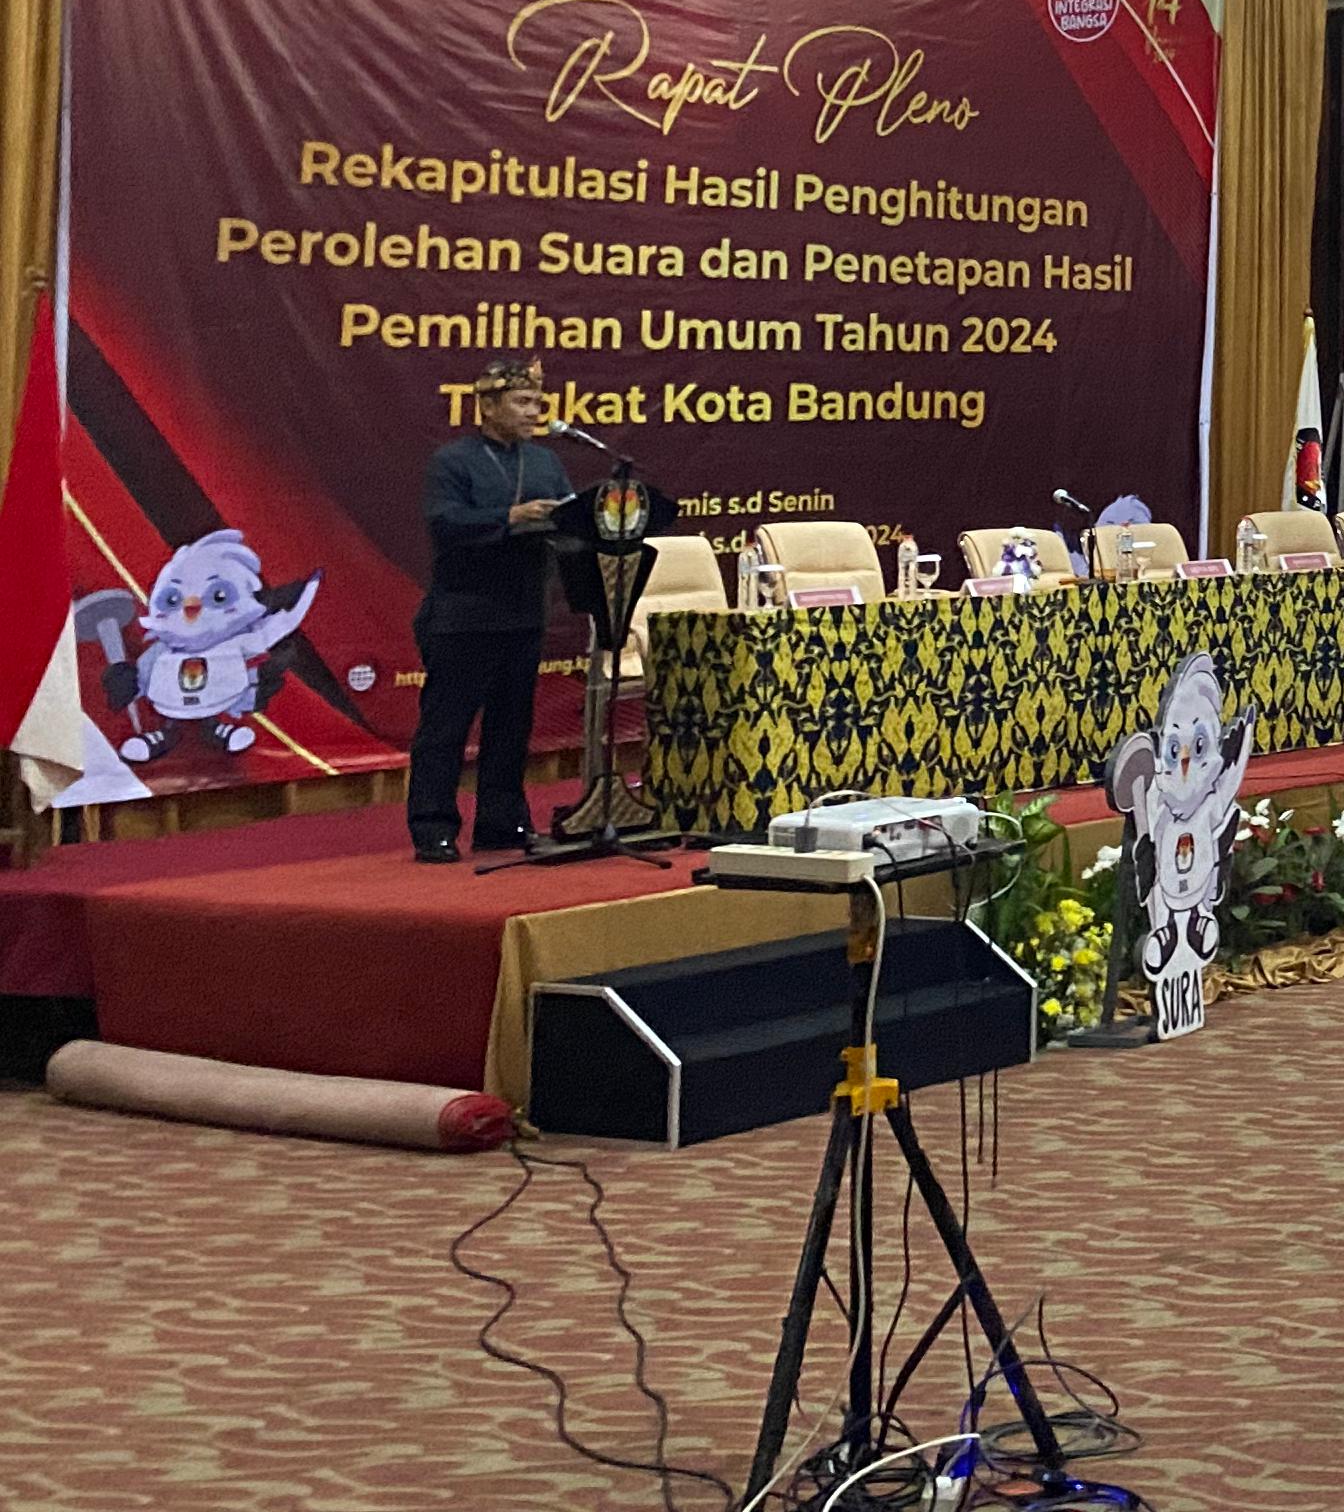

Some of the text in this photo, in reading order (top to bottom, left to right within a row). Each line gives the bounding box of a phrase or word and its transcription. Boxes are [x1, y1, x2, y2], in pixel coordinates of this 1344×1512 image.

[1060, 13, 1108, 32] BANGSA
[784, 24, 980, 144] Pleno
[300, 140, 1089, 233] Rekapitulasi Hasil Penghitungan
[215, 217, 1134, 295] Perolehan Suara dan Penetapan Hasil
[339, 301, 1059, 354] Pemilihan Umum Tahun 2024
[662, 383, 773, 424] Kota
[787, 381, 986, 429] Bandung
[677, 488, 835, 517] mis s.d Senin
[866, 524, 904, 546] 024
[1162, 969, 1202, 1034] SURA
